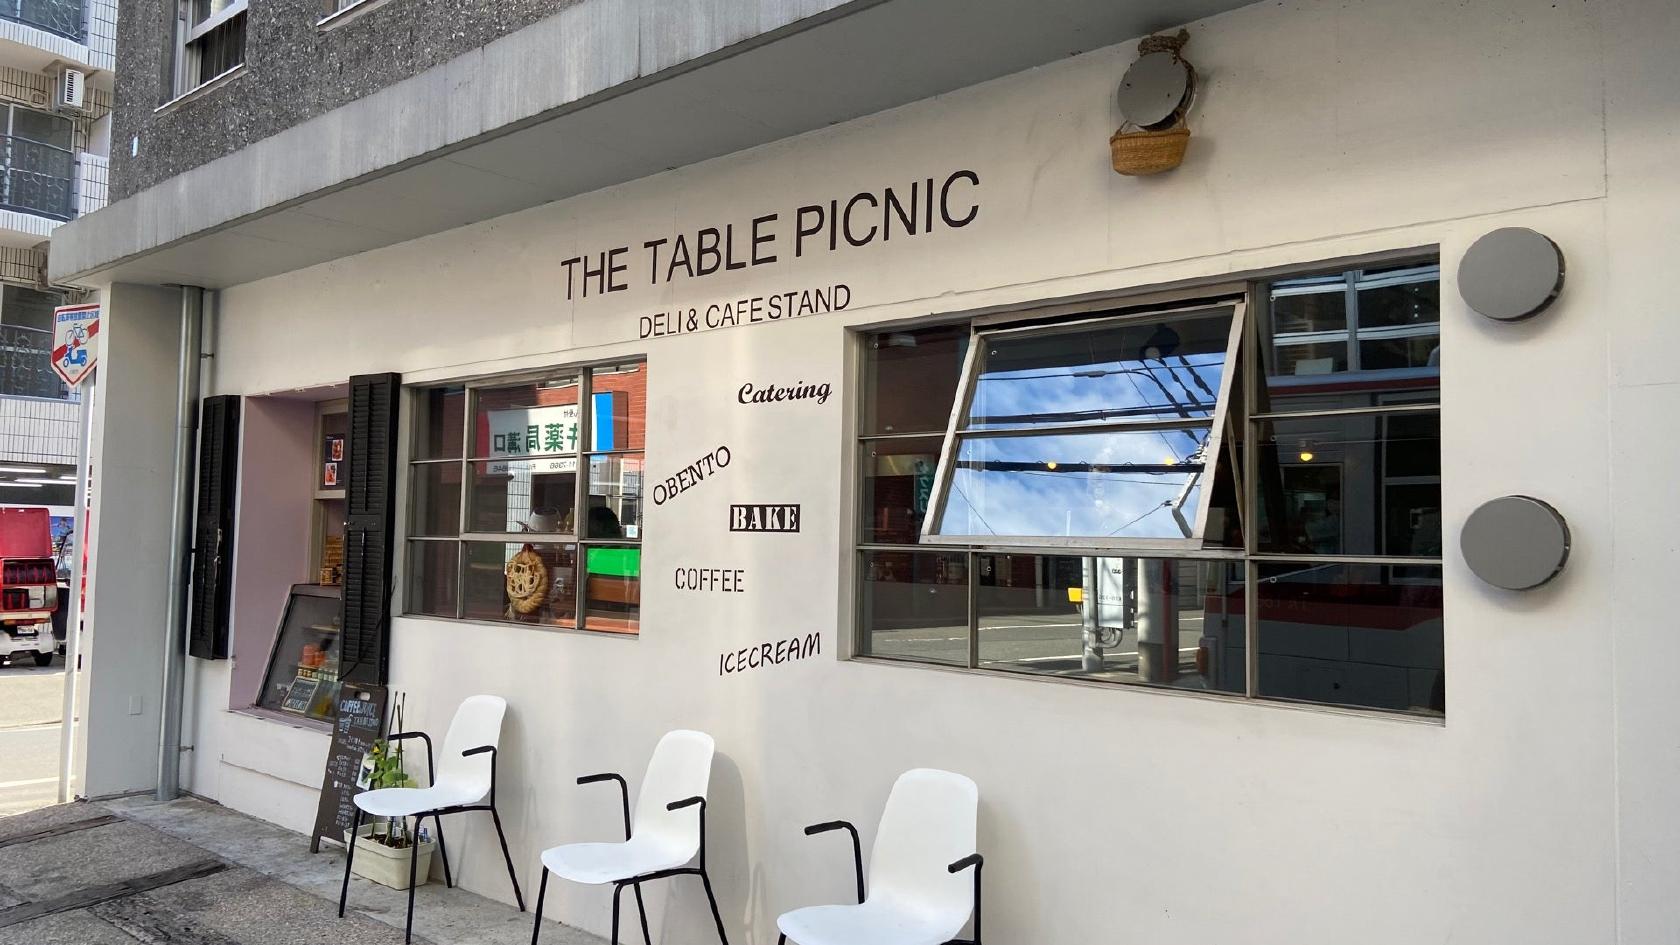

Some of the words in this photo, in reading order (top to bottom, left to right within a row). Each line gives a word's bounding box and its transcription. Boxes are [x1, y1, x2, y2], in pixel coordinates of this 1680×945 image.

[560, 246, 629, 300] THE
[644, 213, 778, 285] TABLE
[795, 169, 980, 258] PICNIC
[639, 310, 682, 339] DELI
[705, 297, 763, 329] CAFE
[768, 284, 851, 320] STAND
[737, 381, 832, 405] Catering
[653, 445, 731, 506] OBENTO
[731, 505, 798, 531] BAKE
[675, 567, 745, 593] COFFEE
[719, 631, 821, 676] ICECREAM
